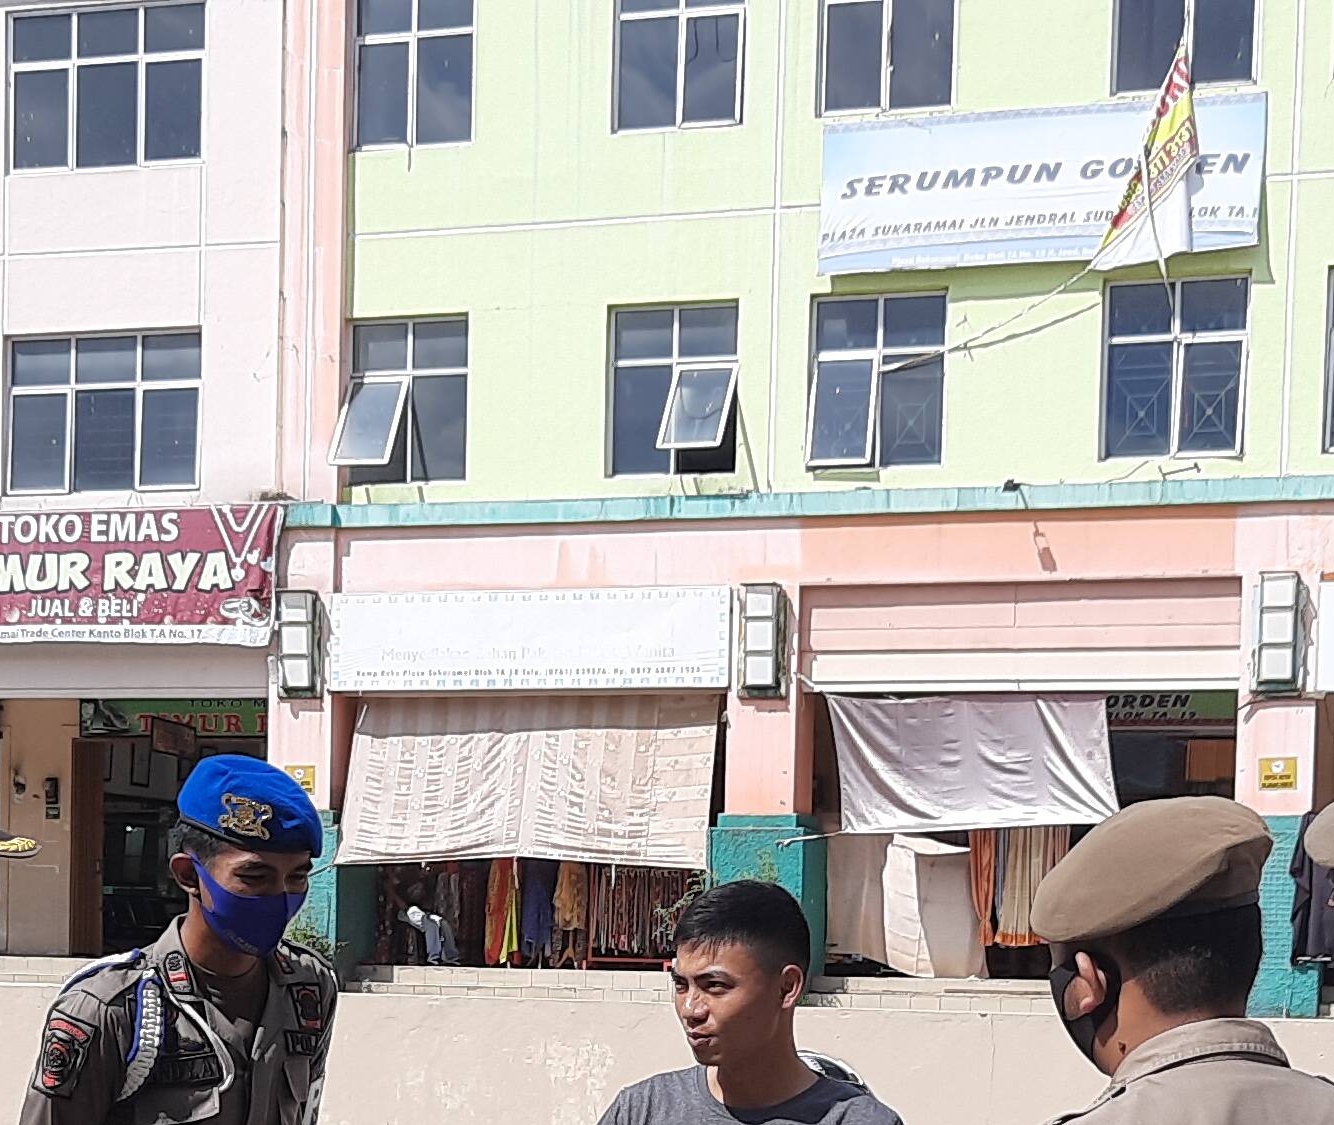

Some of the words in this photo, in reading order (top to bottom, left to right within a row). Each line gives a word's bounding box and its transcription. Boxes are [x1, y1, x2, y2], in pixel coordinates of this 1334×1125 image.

[840, 162, 1063, 200] SERUMPUN
[1080, 153, 1251, 180] GOEN
[871, 218, 965, 238] SUKARAMAI
[1004, 211, 1076, 227] JENDRAL
[88, 512, 180, 543] EMAS
[102, 549, 236, 594] RAYA
[26, 598, 75, 617] JUAL
[78, 596, 94, 617] &
[97, 598, 139, 618] BELI
[21, 628, 49, 639] Trade
[50, 628, 87, 639] Center
[88, 628, 122, 639] Kanto
[123, 628, 148, 639] Blok
[1105, 693, 1191, 710] ORDEN
